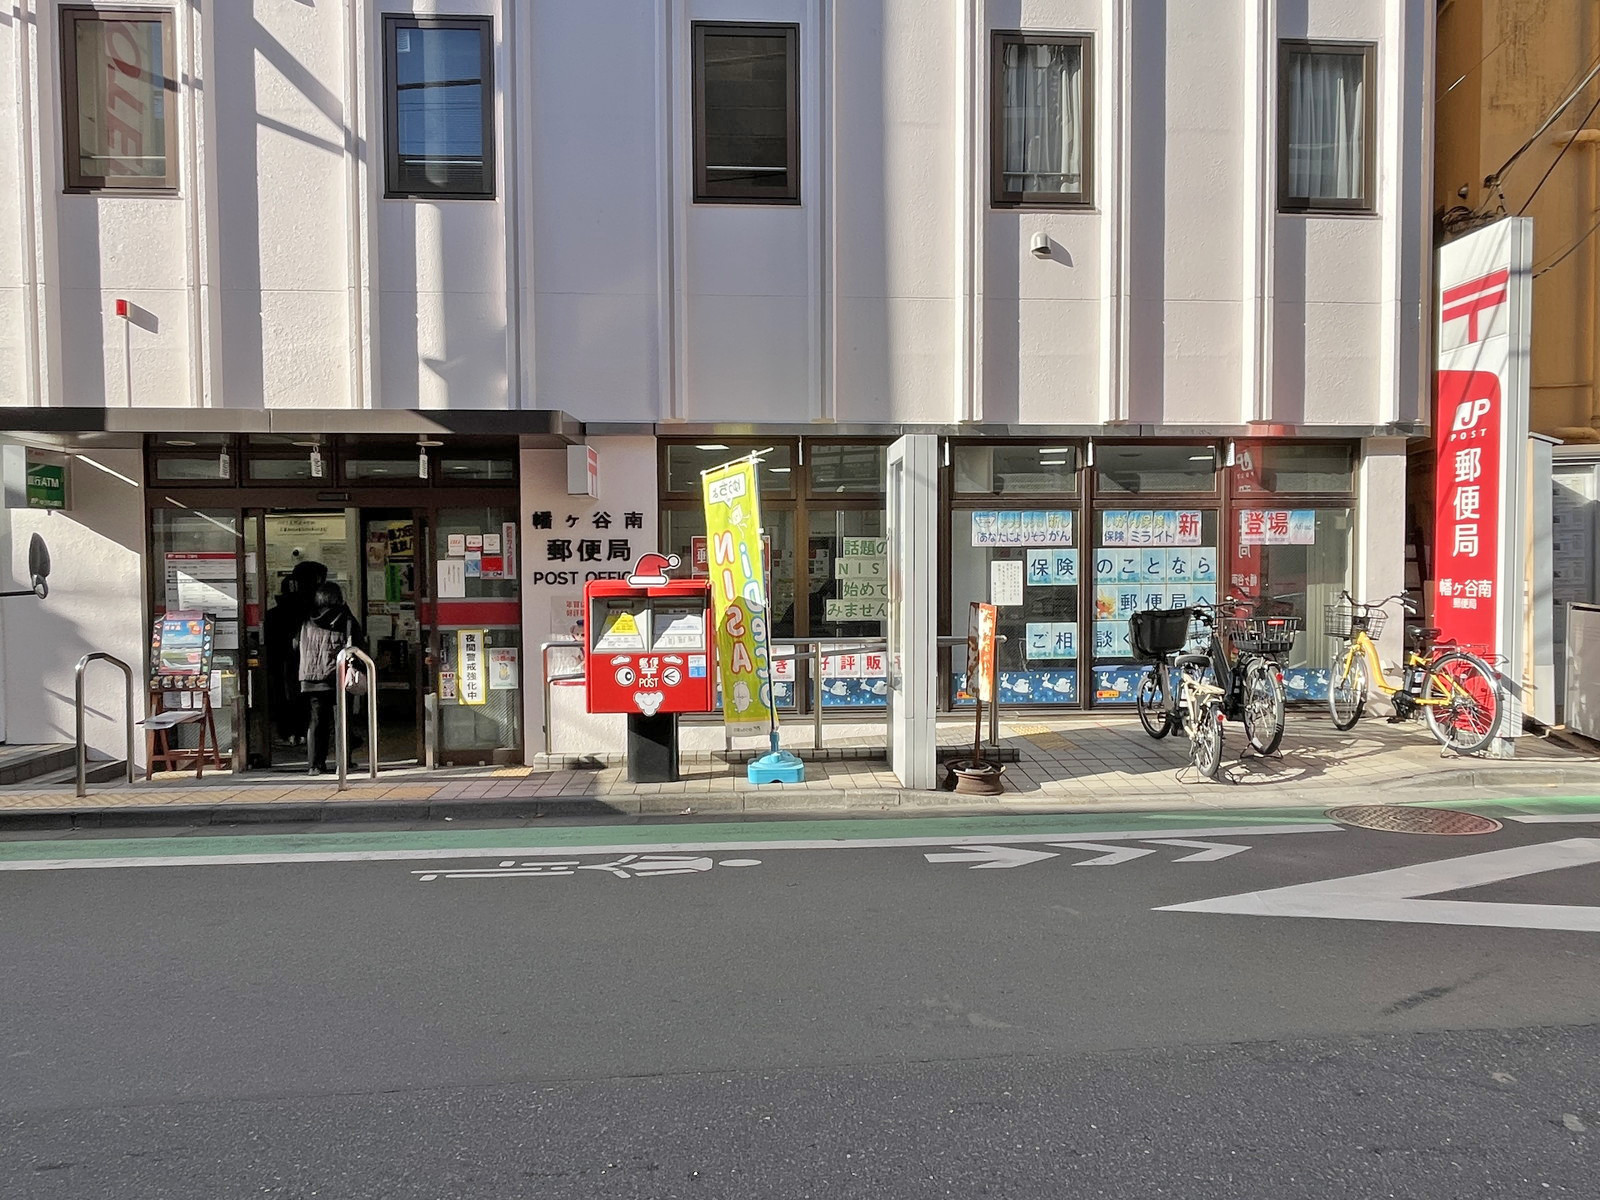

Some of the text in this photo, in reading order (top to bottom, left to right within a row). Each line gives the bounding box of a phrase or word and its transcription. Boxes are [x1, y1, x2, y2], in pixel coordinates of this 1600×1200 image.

[1450, 428, 1487, 442] POST
[1452, 447, 1482, 557] 郵便局
[532, 511, 643, 529] 幡ヶ谷南
[1178, 512, 1288, 536] 新 登場
[547, 539, 631, 562] 郵便局
[844, 540, 887, 556] 話題の
[1031, 556, 1211, 577] 保険 のことなら
[533, 571, 632, 585] POST OFFI
[843, 582, 887, 597] 始めて
[1439, 579, 1492, 598] 幡ヶ谷南
[827, 603, 887, 618] みません
[1120, 593, 1213, 612] 郵便局へ
[1032, 631, 1073, 650] ご相
[465, 634, 477, 700] 夜間警戒強化中
[638, 657, 660, 670] 郵便
[638, 678, 660, 688] POST
